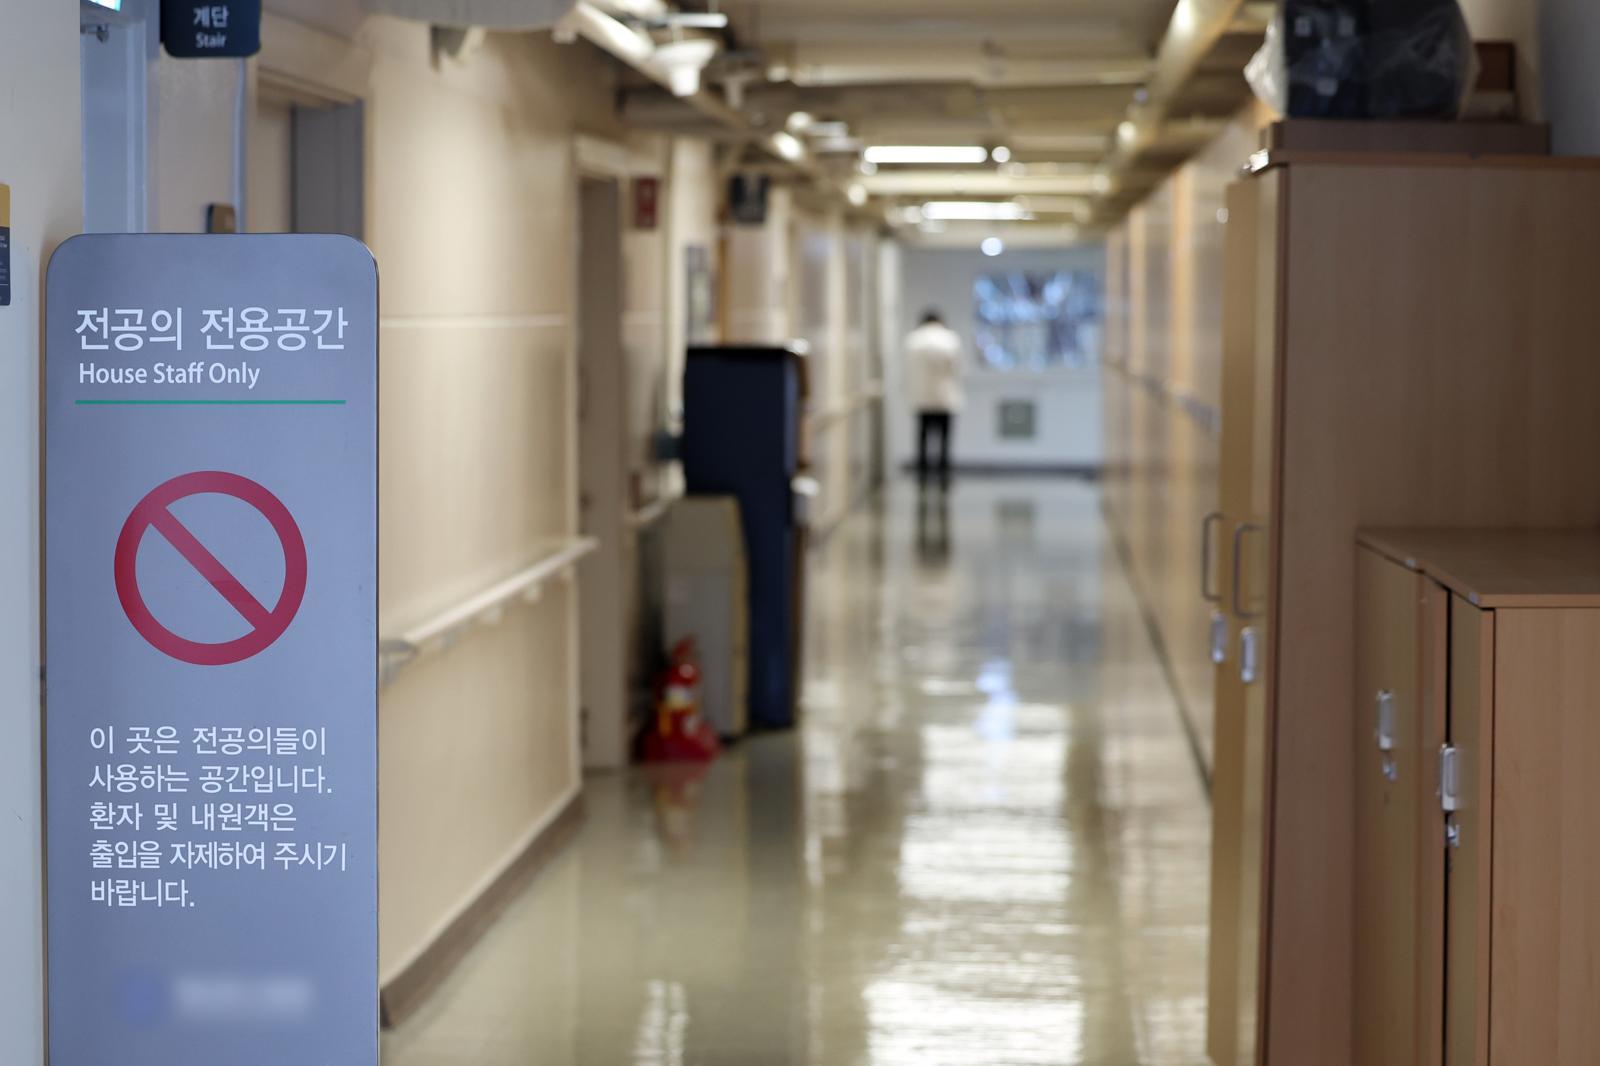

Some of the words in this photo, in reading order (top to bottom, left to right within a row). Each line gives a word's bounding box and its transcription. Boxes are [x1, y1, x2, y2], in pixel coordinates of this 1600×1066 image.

[193, 5, 229, 28] 계단
[195, 32, 227, 48] Stair
[74, 306, 183, 352] 전공의
[199, 306, 349, 352] 전용공간
[79, 362, 148, 384] House
[153, 361, 205, 384] Staff
[208, 361, 261, 390] Only
[90, 725, 114, 755] 이
[126, 725, 181, 755] 곳은
[192, 726, 327, 756] 전공의들이
[88, 763, 190, 793] 사용하는
[198, 764, 333, 794] 공간입니다.
[89, 801, 144, 831] 환자
[154, 802, 178, 831] 및
[191, 802, 297, 832] 내원객은
[89, 839, 163, 869] 출입을
[169, 840, 266, 870] 자제하여
[273, 841, 347, 872] 주시기
[91, 878, 195, 908] 바랍니다.
